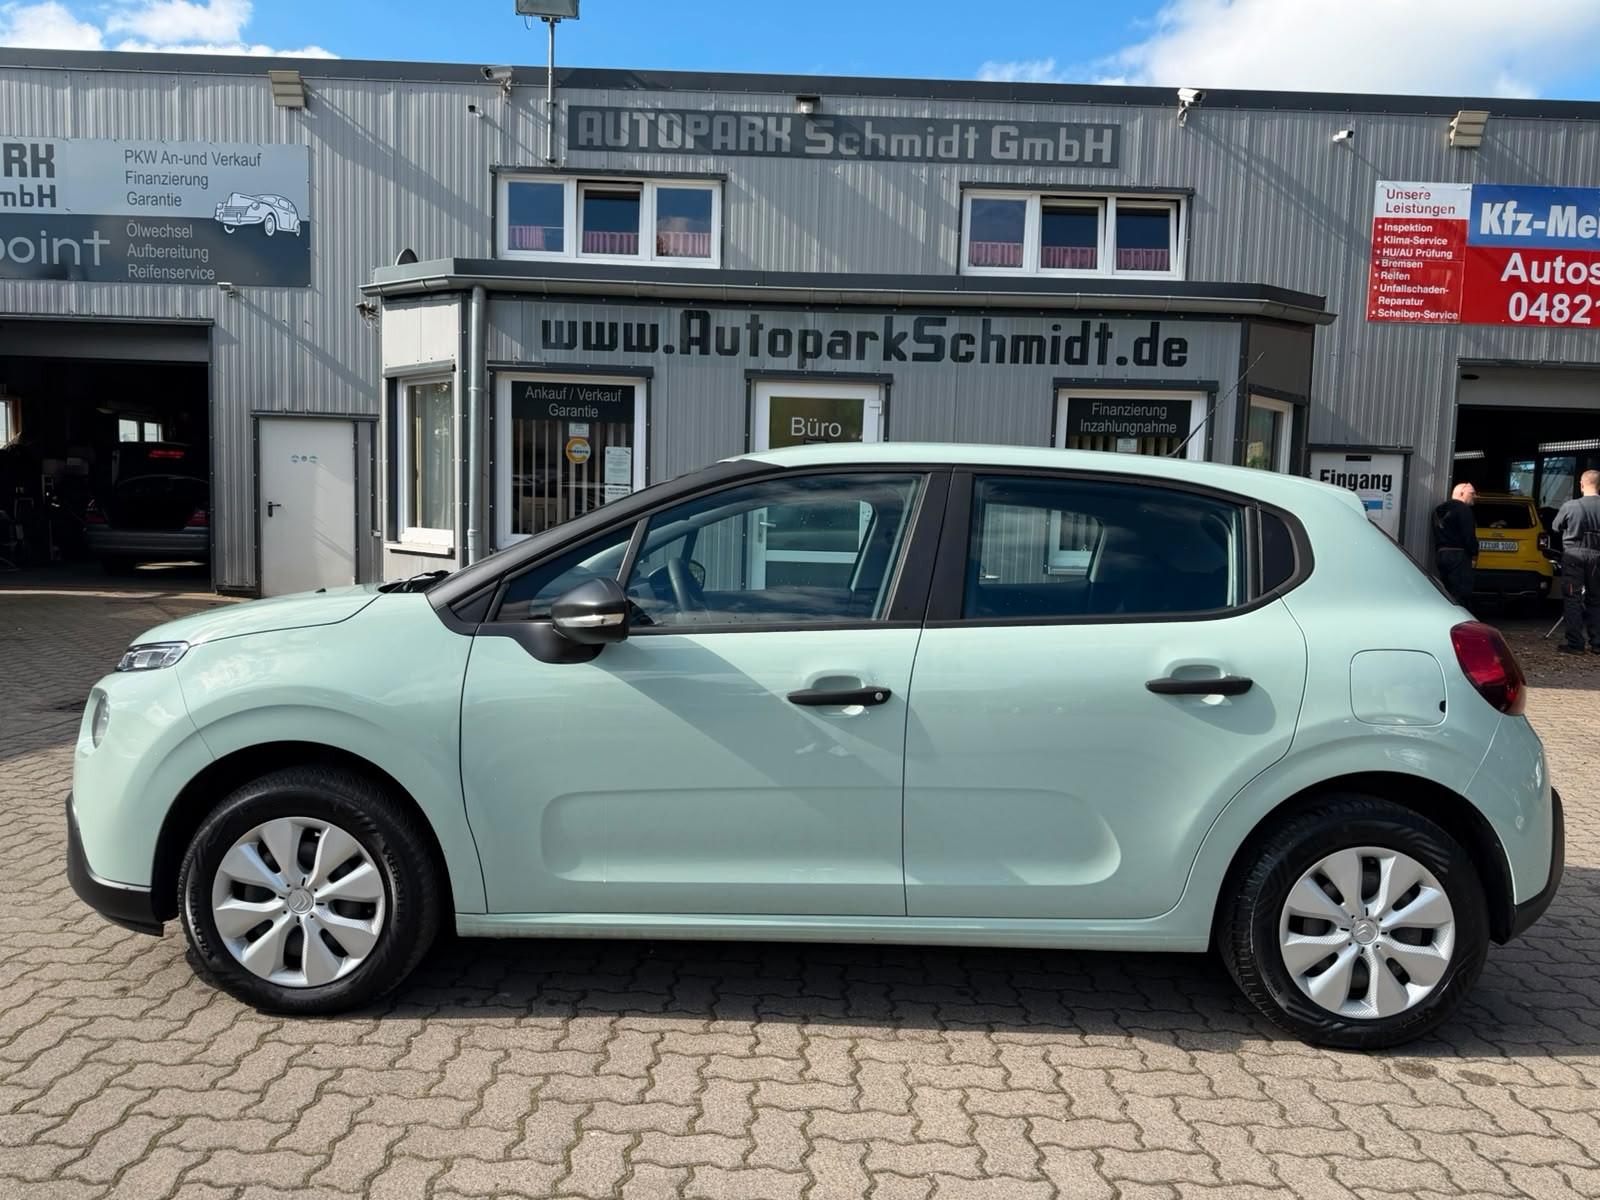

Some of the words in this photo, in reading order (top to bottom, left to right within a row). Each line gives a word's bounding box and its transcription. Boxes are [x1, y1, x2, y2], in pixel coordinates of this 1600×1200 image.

[578, 111, 792, 152] AUTOPARK
[805, 120, 979, 159] Schmidt
[991, 125, 1113, 163] GmbH
[124, 149, 157, 165] PKW
[161, 152, 207, 167] An-und
[211, 152, 262, 168] Verkauf
[125, 170, 209, 190] Finanzierung
[126, 191, 182, 208] Garantie
[1386, 188, 1431, 201] Unsere
[1385, 202, 1456, 217] Leistungen
[126, 218, 193, 239] Ölwechsel
[1384, 223, 1433, 234] Inspektion
[0, 230, 110, 267] oint
[1383, 236, 1448, 246] Klima-Service
[127, 243, 209, 264] Aufbereitung
[1382, 248, 1413, 258] HU/AU
[1415, 248, 1453, 260] Prüfung
[127, 264, 215, 280] Reifenservice
[1381, 260, 1423, 269] Bremsen
[1380, 271, 1411, 281] Reifen
[1379, 284, 1449, 295] Unfallschaden-
[1378, 297, 1424, 308] Reparatur
[1508, 291, 1600, 324] 0482
[1377, 309, 1459, 320] Scheiben-Service
[541, 310, 1189, 369] www.AutoparkSchmidt.de
[525, 386, 568, 400] Ankauf
[569, 388, 574, 400] /
[577, 388, 622, 402] Verkauf
[548, 403, 599, 418] Garantie
[1091, 402, 1167, 420] Finanzierung
[791, 417, 841, 437] Büro
[1080, 418, 1177, 436] Inzahlungnahme
[1320, 469, 1392, 492] Eingang
